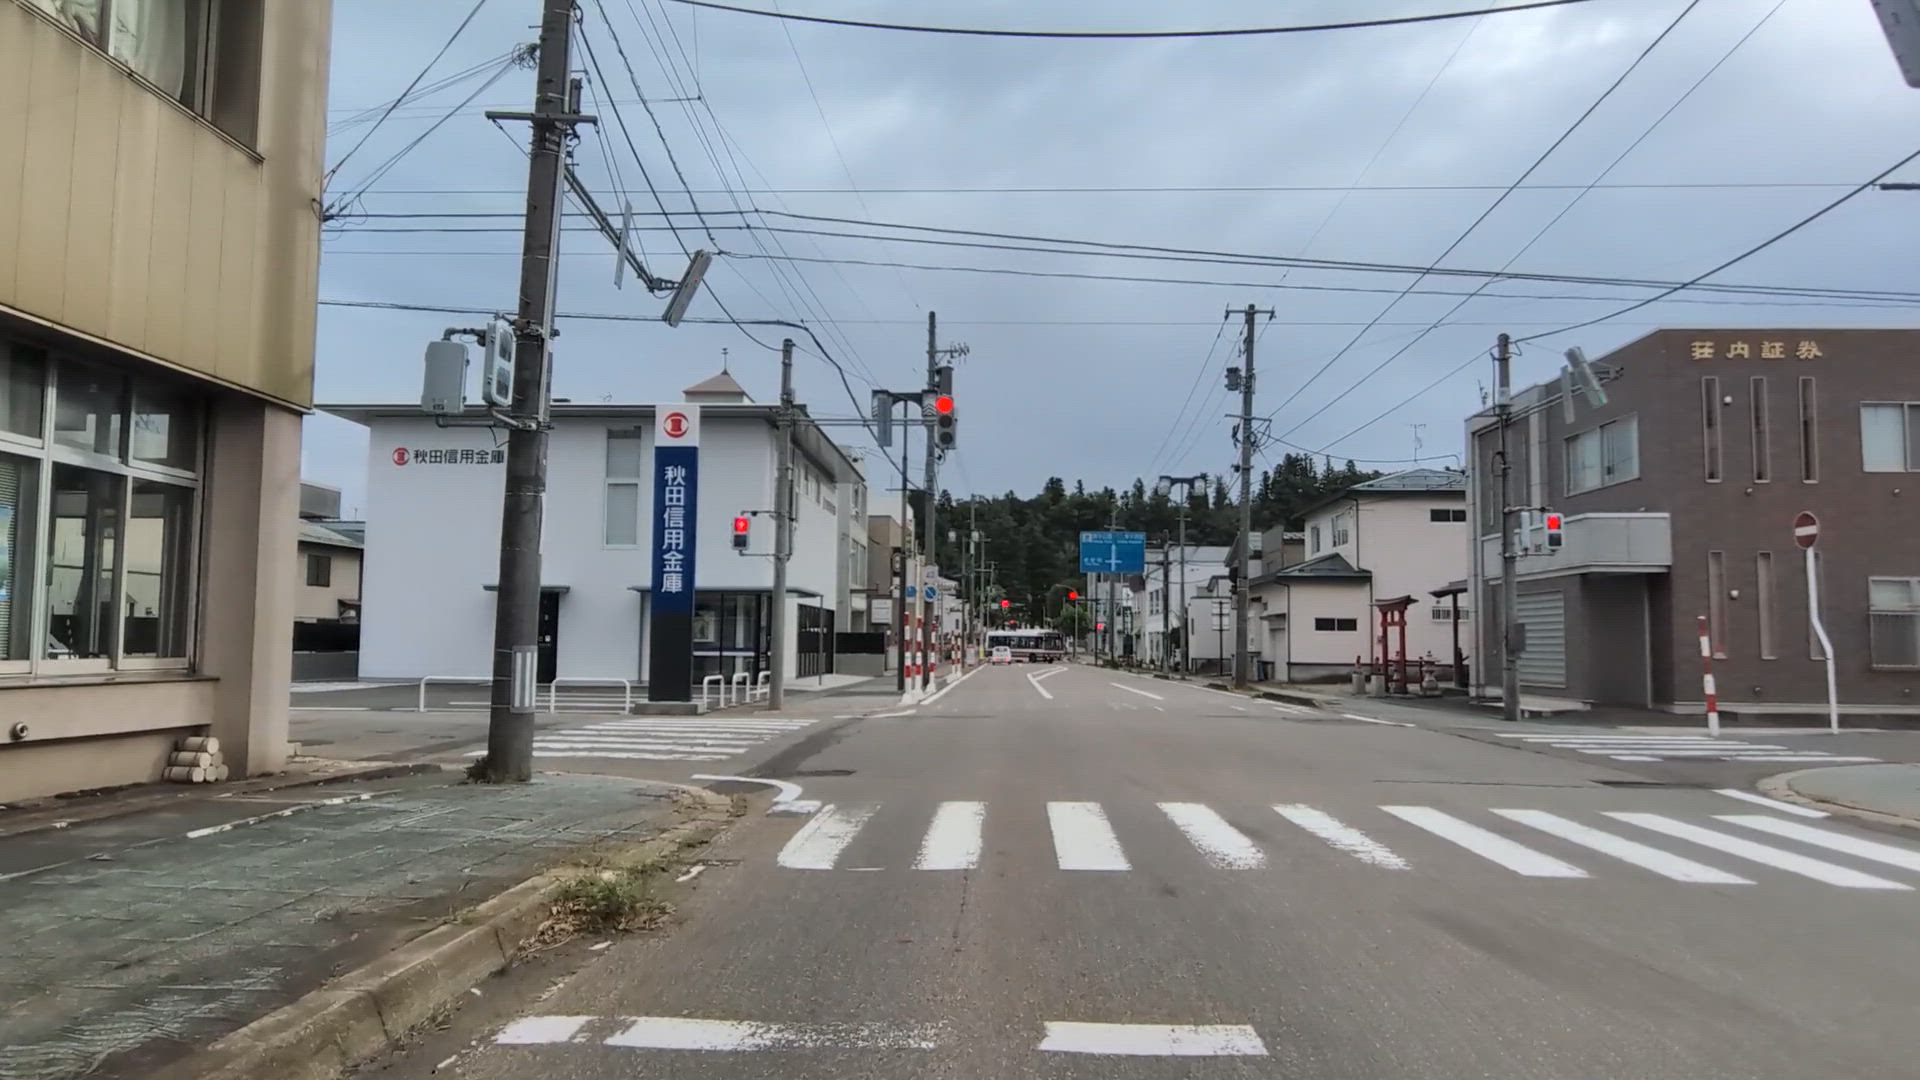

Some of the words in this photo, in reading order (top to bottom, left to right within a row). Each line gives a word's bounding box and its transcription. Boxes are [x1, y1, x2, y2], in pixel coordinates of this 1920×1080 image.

[1691, 341, 1823, 359] 荘内証券
[413, 449, 504, 464] 秋田信用金庫
[661, 465, 686, 593] 秋田信用金庫
